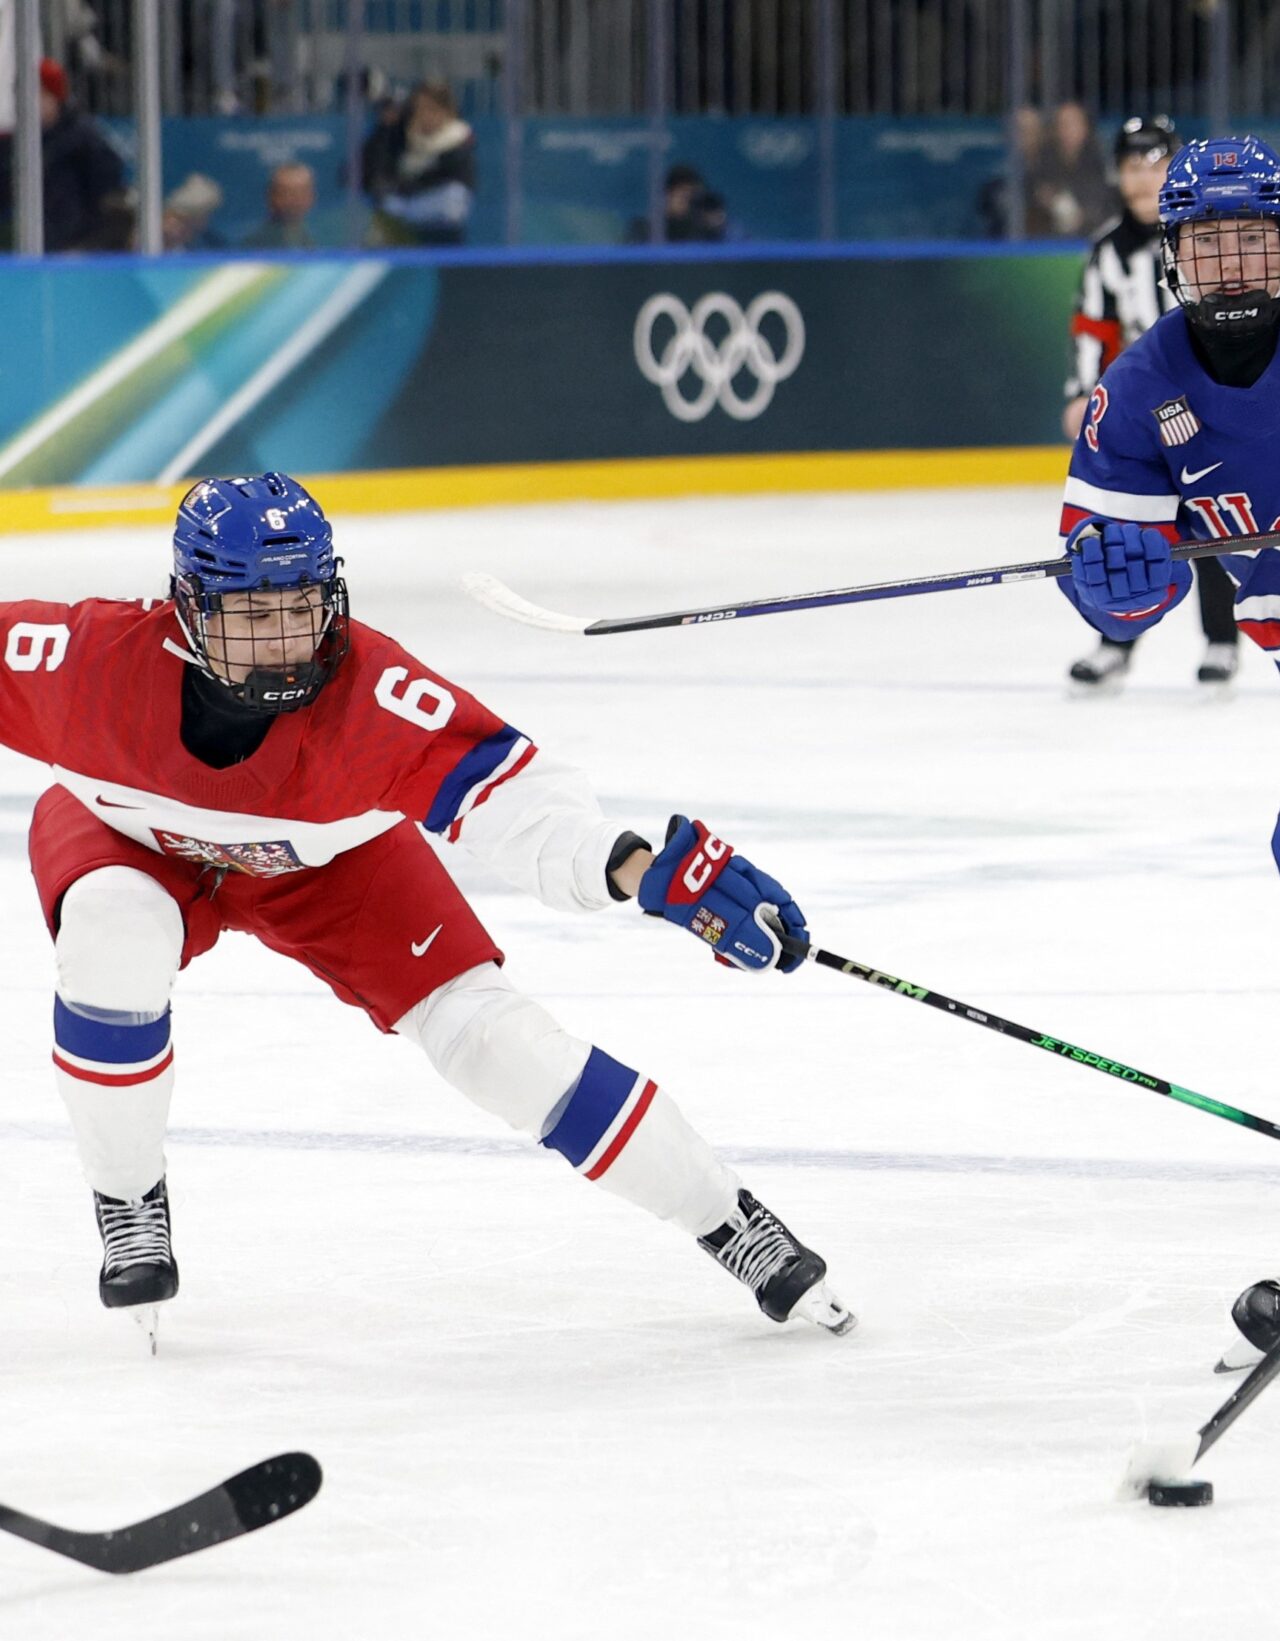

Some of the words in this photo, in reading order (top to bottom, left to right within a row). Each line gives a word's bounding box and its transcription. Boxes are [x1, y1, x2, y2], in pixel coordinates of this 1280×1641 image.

[1212, 152, 1238, 167] 13
[1214, 307, 1259, 321] CCM
[1084, 383, 1109, 453] 3
[1158, 402, 1185, 421] USA
[265, 508, 286, 531] 6
[697, 609, 738, 624] CCM
[4, 621, 72, 673] 6
[373, 665, 457, 732] 6
[682, 834, 727, 894] CC
[733, 940, 768, 963] CCM
[841, 960, 929, 1001] CCM
[1030, 1033, 1140, 1082] JETSPEED
